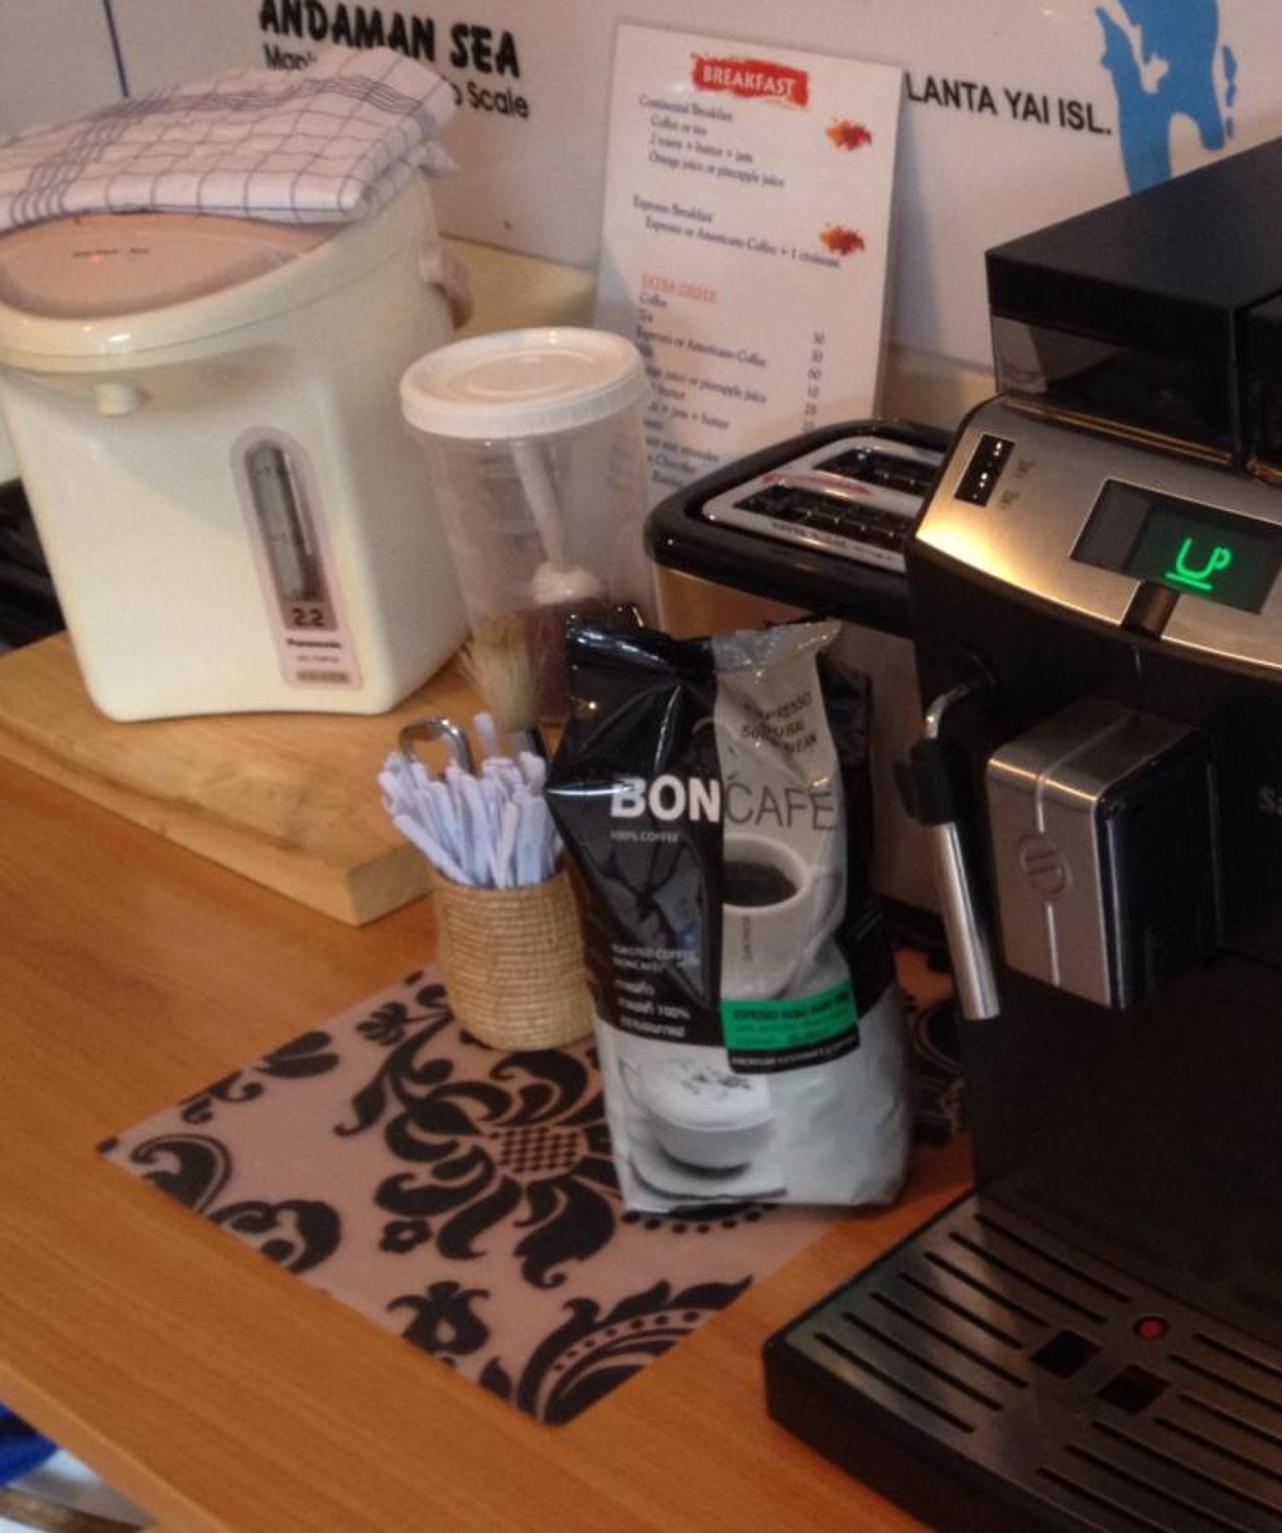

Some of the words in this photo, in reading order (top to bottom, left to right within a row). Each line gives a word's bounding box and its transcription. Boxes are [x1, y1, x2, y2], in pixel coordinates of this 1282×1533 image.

[259, 0, 435, 61] ANDAMAN
[450, 23, 520, 78] SEA
[702, 65, 797, 97] BREAKFAST
[467, 81, 530, 119] Scale
[904, 71, 998, 116] LANTA
[1003, 87, 1050, 125] YAI
[1058, 98, 1112, 136] ISL.
[650, 114, 679, 131] Coffee
[640, 830, 679, 844] COFFEE
[657, 1004, 691, 1019] 100%
